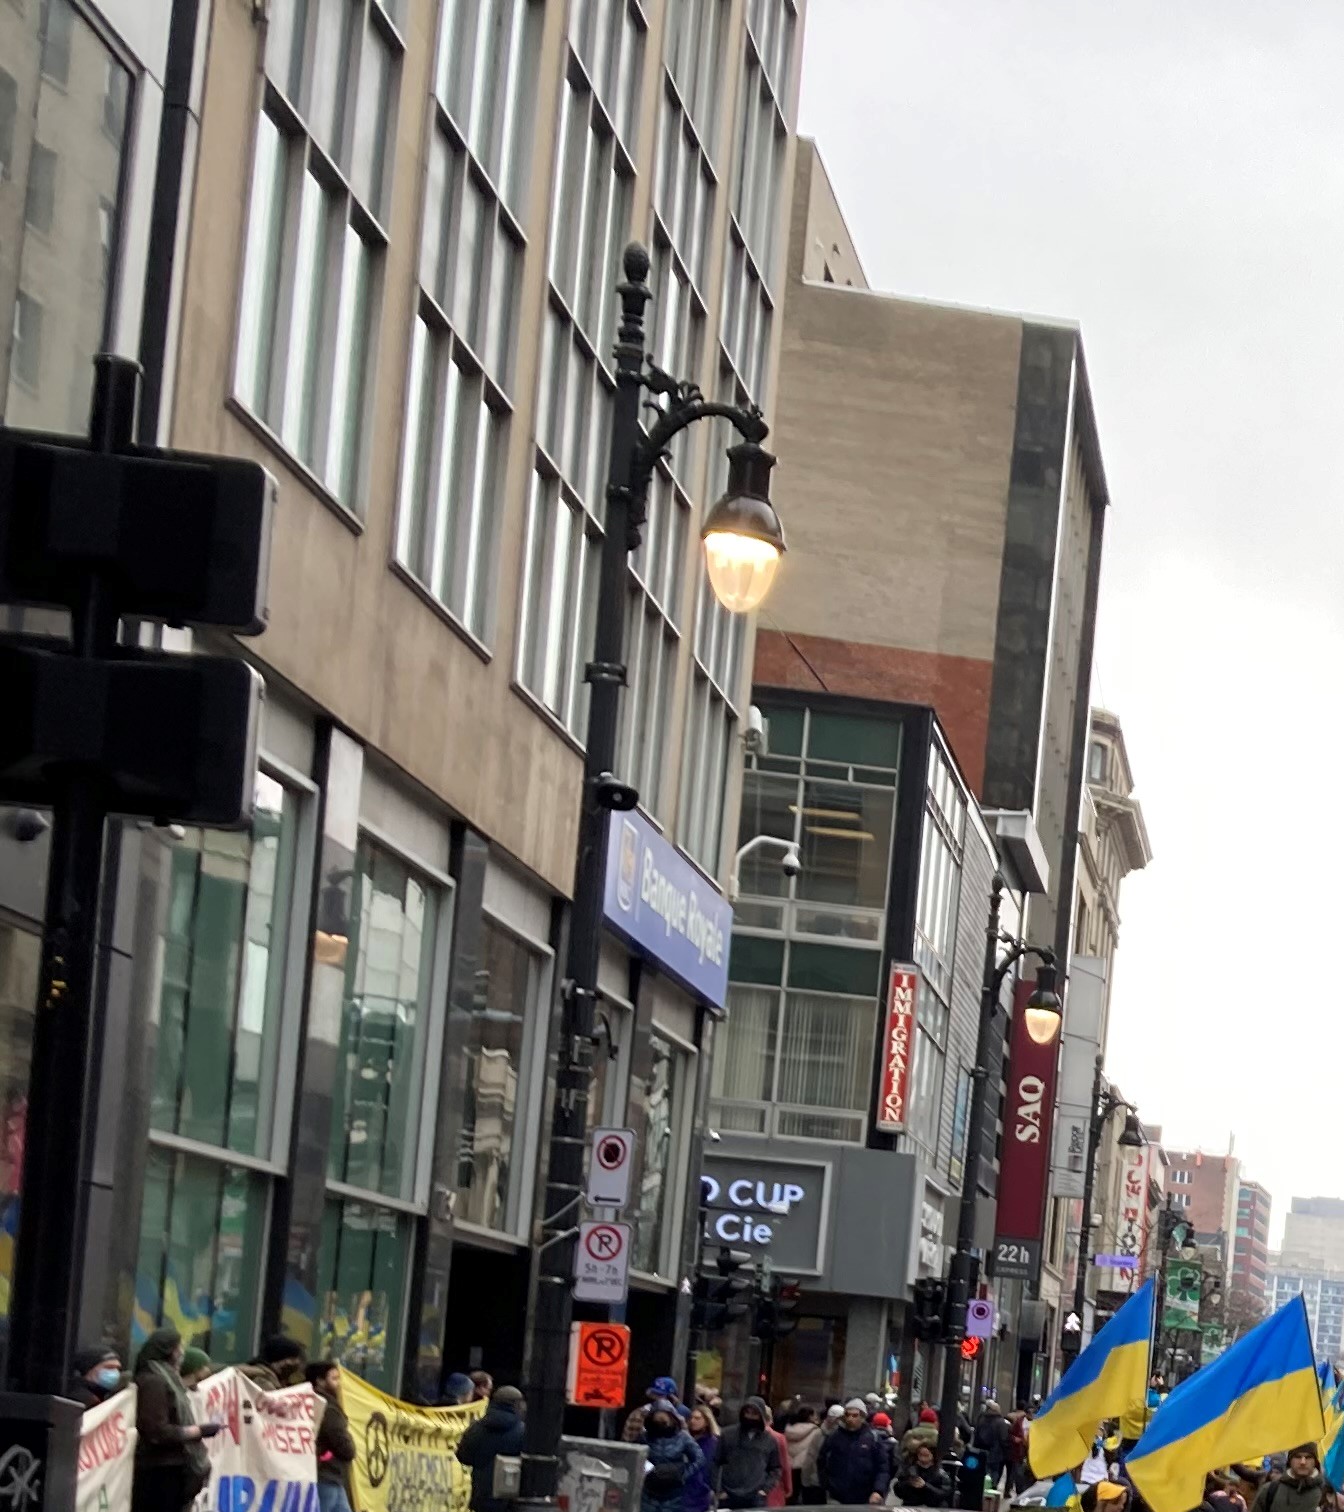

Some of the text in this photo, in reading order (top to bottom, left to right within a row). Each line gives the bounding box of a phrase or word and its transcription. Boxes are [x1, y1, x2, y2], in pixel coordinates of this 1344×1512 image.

[641, 846, 724, 967] Banque Royale
[883, 974, 913, 1122] IMMIGRATION
[1015, 1075, 1047, 1144] SAQ
[716, 1214, 773, 1244] Cie
[729, 1180, 804, 1211] CUP
